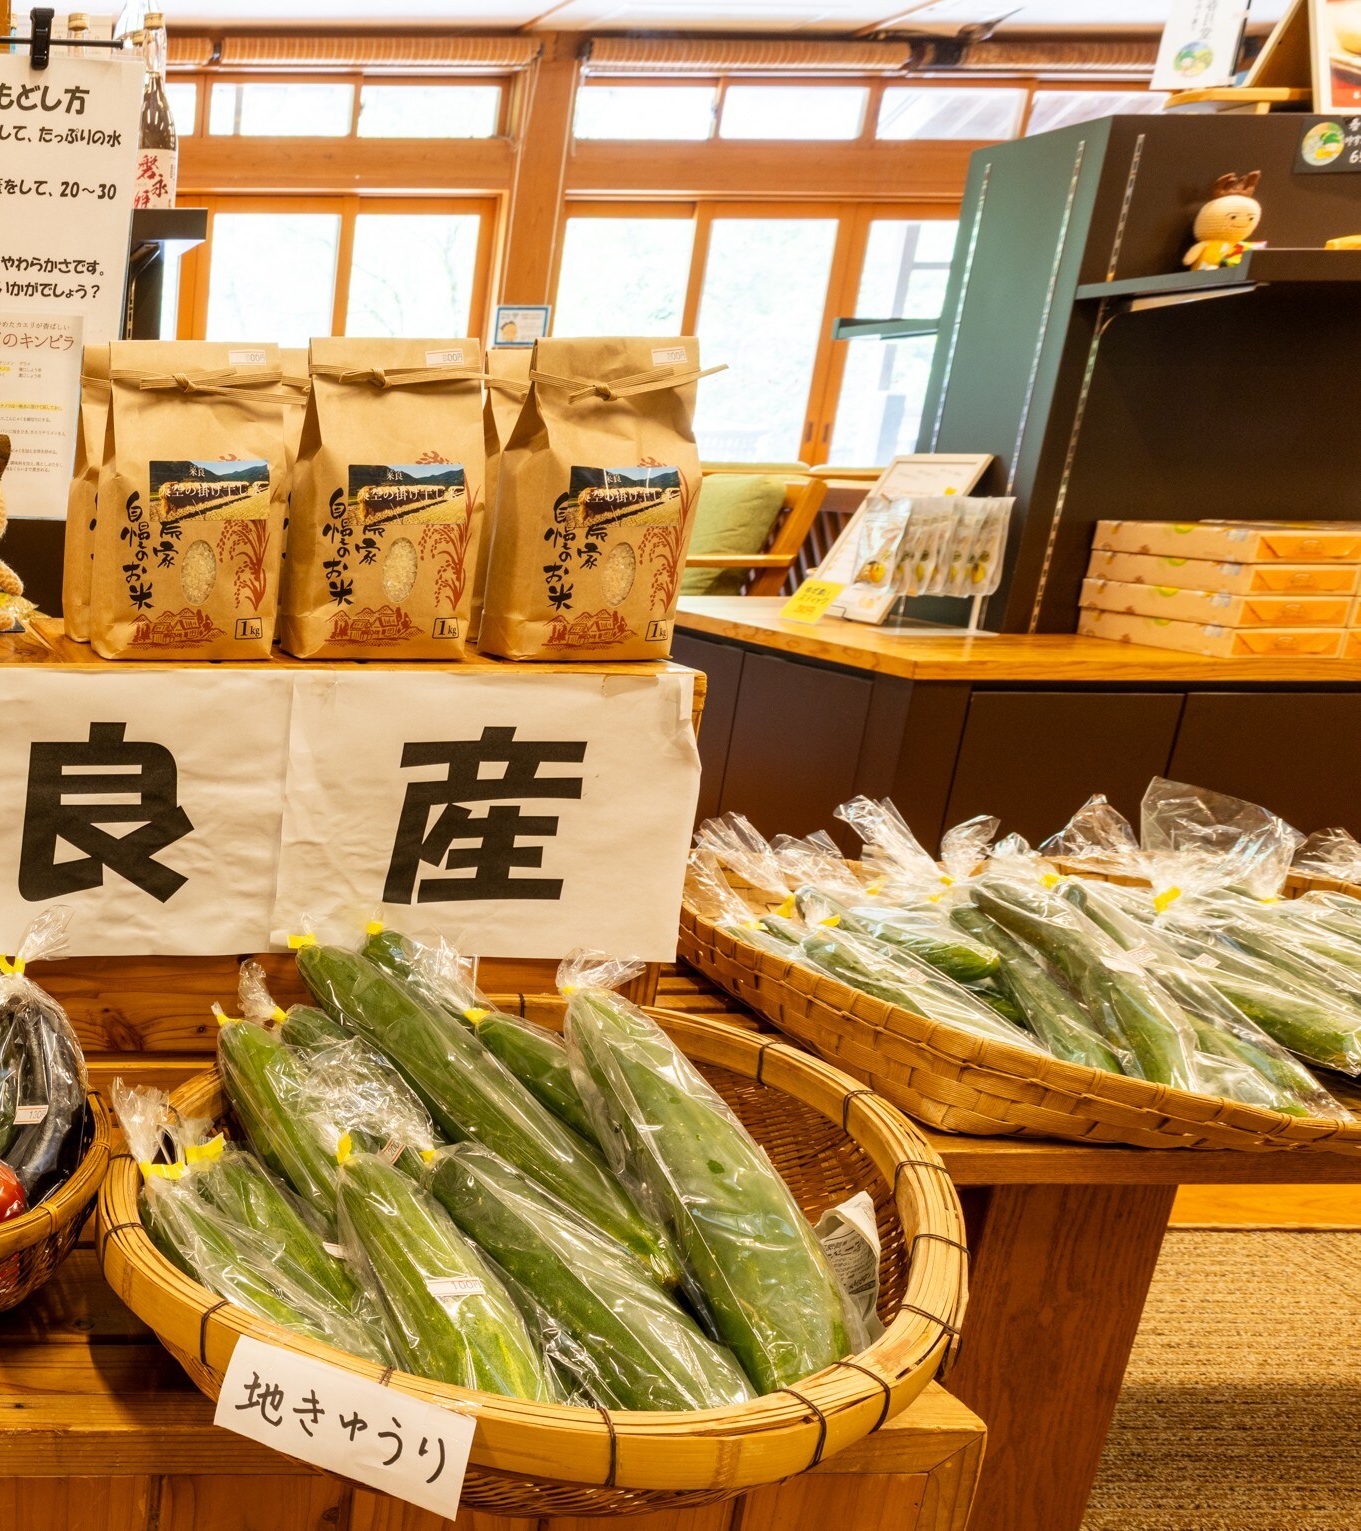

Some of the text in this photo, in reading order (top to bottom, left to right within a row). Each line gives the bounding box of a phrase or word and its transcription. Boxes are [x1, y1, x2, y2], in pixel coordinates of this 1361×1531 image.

[120, 487, 156, 611] 自慢のお米
[323, 487, 355, 608] 自慢のお米
[240, 619, 263, 639] 1kg
[436, 619, 458, 638] 1kg
[649, 621, 669, 639] 1kg
[234, 1371, 446, 1484] 地きゅうり
